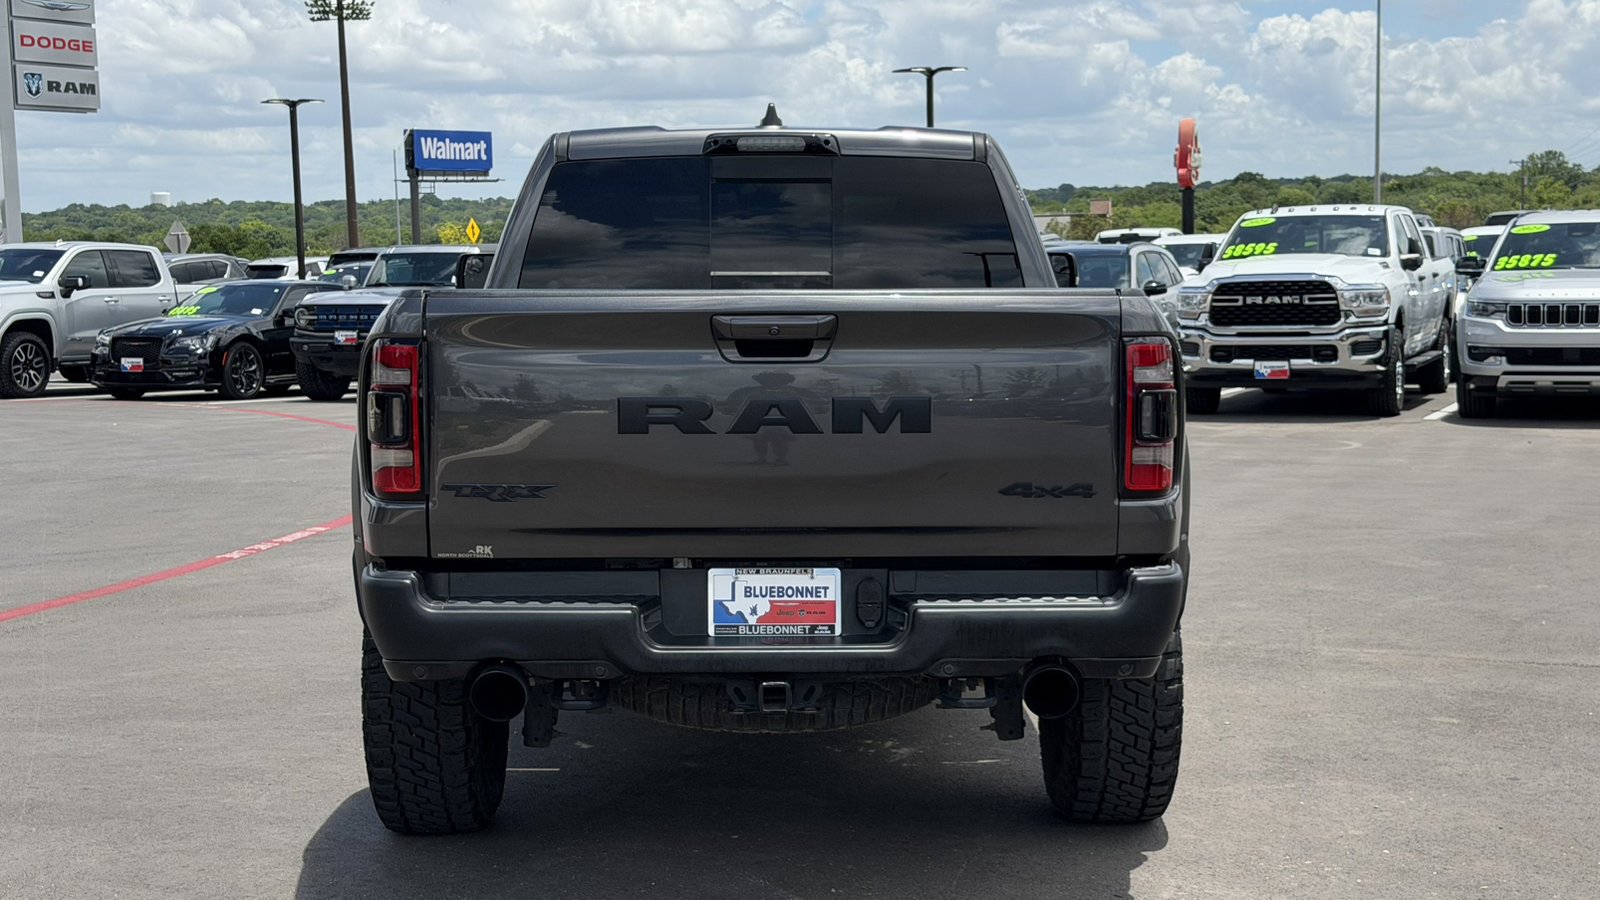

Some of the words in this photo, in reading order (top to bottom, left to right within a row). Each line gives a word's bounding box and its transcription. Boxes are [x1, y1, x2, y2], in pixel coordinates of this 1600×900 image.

[20, 34, 93, 53] DODGE
[47, 80, 96, 95] RAM
[420, 136, 487, 161] Walmart
[1222, 242, 1279, 259] 58595
[1494, 253, 1557, 271] 35875
[1245, 295, 1301, 305] RAM
[617, 396, 932, 434] RAM
[440, 483, 557, 503] TRX
[744, 586, 829, 598] BLUEBONNET
[739, 626, 810, 634] BLUEBONNET
